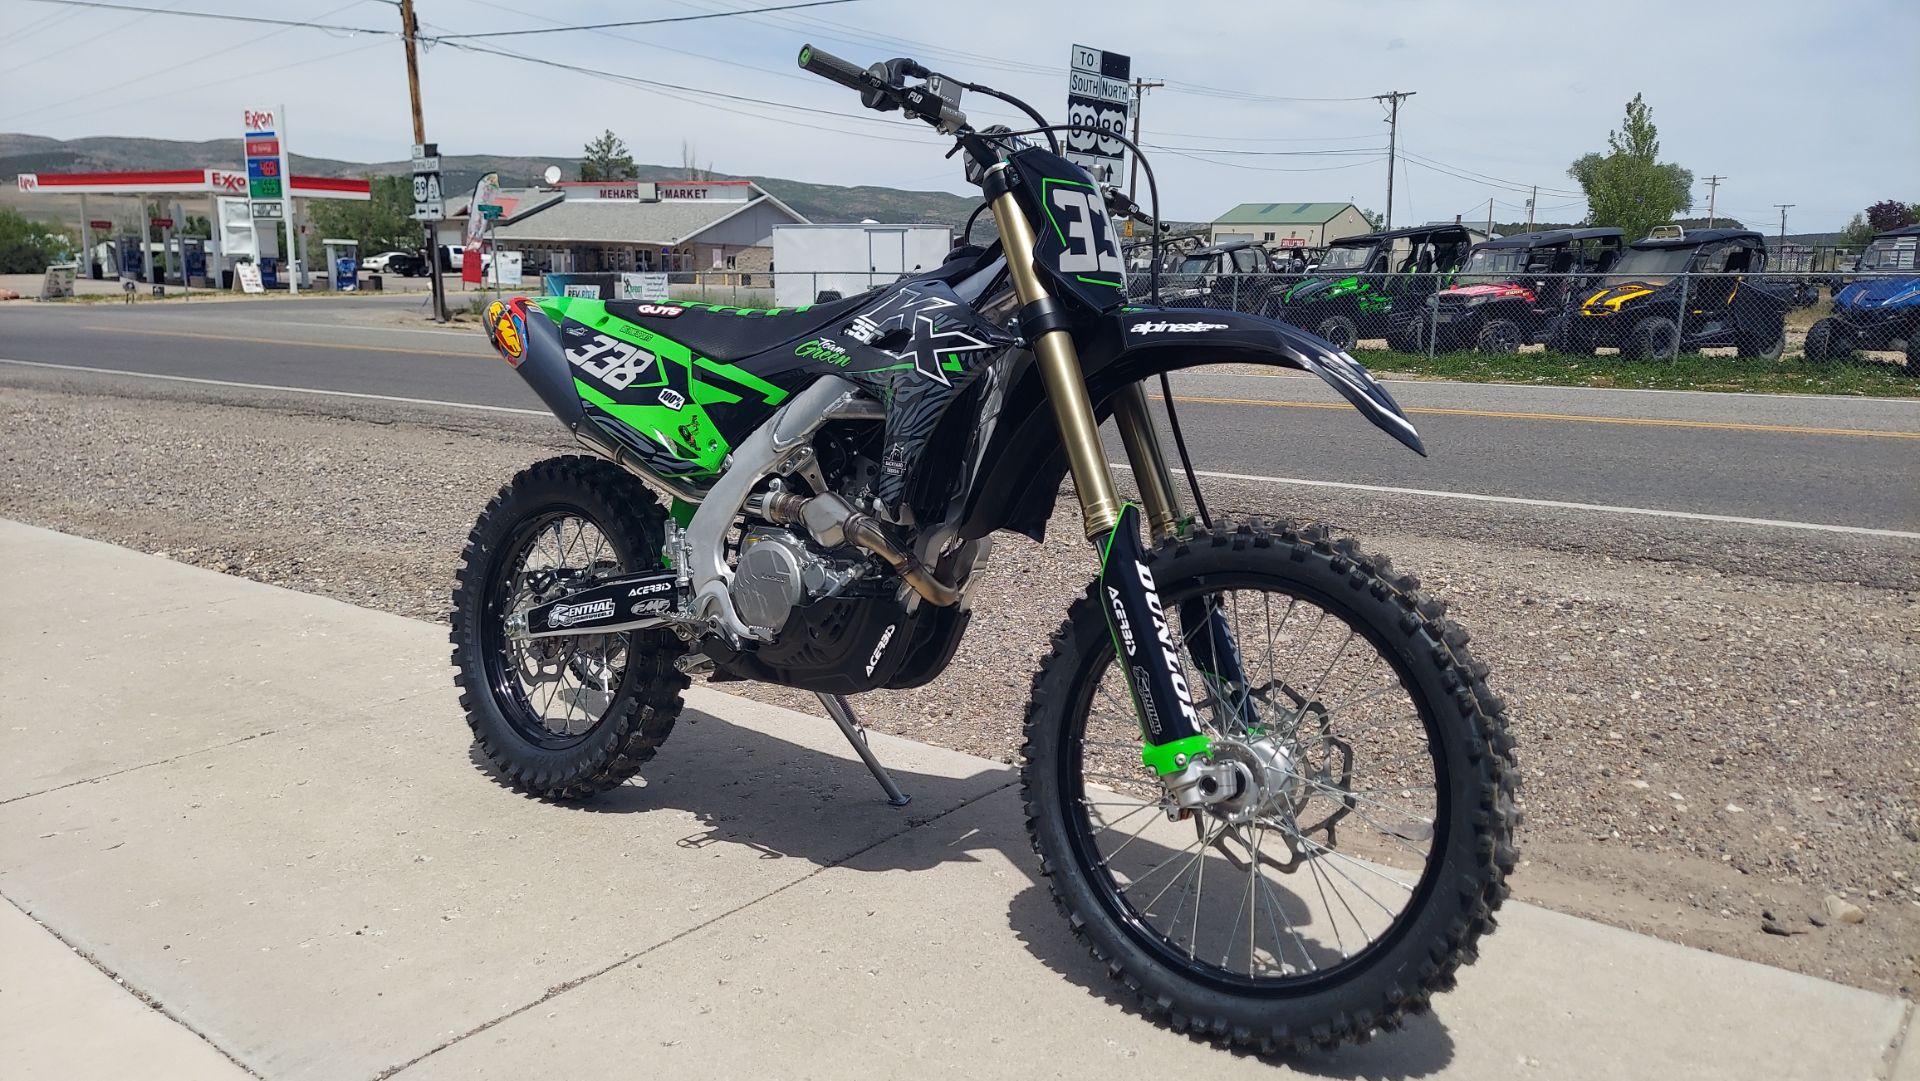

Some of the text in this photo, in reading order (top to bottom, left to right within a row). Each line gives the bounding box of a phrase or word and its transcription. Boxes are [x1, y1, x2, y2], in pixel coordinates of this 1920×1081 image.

[1079, 51, 1095, 67] TO
[1071, 75, 1099, 96] SOUTH
[1101, 81, 1128, 102] NORTH
[1071, 112, 1095, 139] 89
[212, 172, 246, 191] Exxo
[415, 181, 426, 195] 89
[665, 189, 708, 199] MARKET
[637, 304, 682, 316] GUTS
[794, 339, 851, 367] Green
[819, 336, 846, 354] Team
[565, 334, 656, 391] 338
[660, 390, 684, 408] 100%
[628, 582, 672, 597] ACERBIS
[549, 601, 614, 627] RENTHAL
[1107, 585, 1137, 657] ACERBIS
[865, 624, 896, 678] ACERBIS
[1135, 559, 1201, 733] DUNLOP
